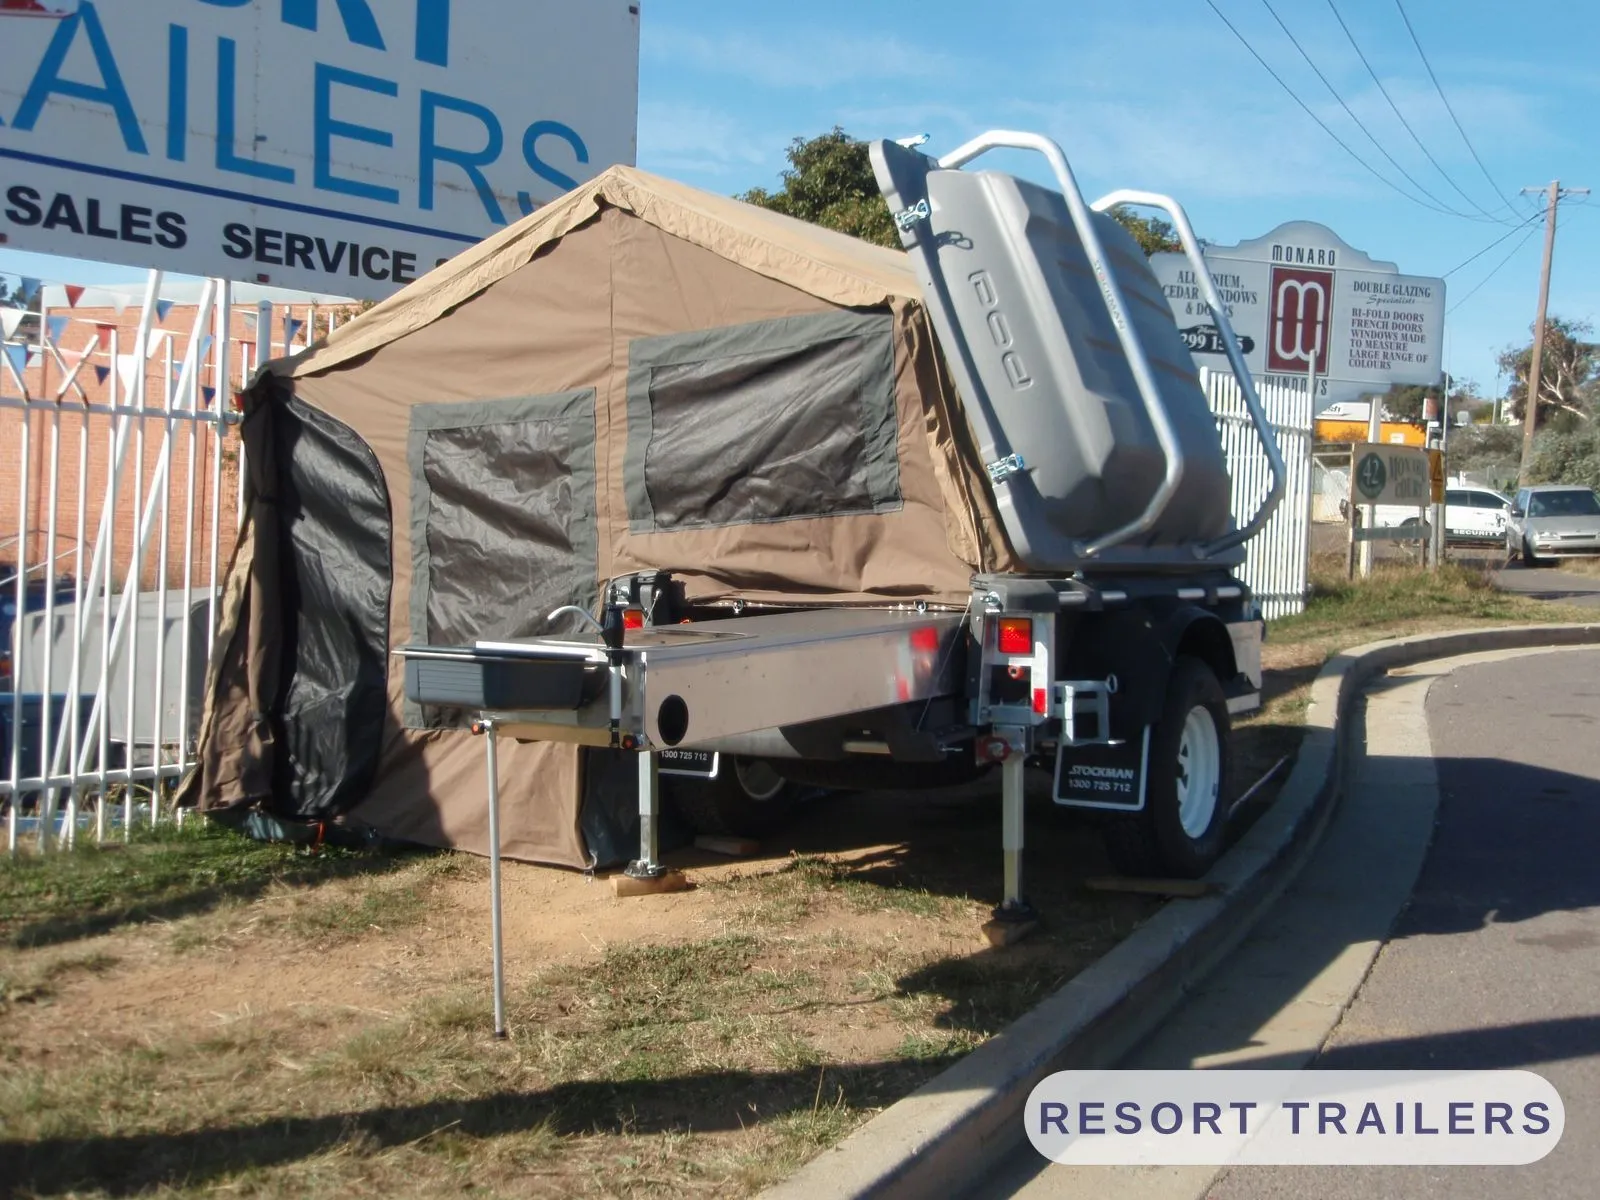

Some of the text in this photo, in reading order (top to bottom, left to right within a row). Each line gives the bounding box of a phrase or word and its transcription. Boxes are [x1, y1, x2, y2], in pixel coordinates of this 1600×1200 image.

[0, 0, 590, 226] AILERS
[5, 186, 417, 284] SALES SERVICE
[1272, 244, 1335, 266] MONARO
[1177, 270, 1245, 290] ALUNIUM,
[1162, 284, 1199, 300] CEDAR
[1353, 280, 1431, 299] DOUBLE GLAZING
[1185, 302, 1193, 315] &
[1352, 307, 1424, 323] BI-FOLD DOORS
[1351, 318, 1423, 334] FRENCH DOORS
[1351, 329, 1426, 344] WINDOWS MADE
[1350, 339, 1408, 351] TO MEASURE
[1349, 349, 1429, 364] LARGE RANGE OF
[1348, 359, 1391, 370] COLOURS
[1453, 529, 1501, 537] SECURITY
[661, 750, 708, 761] 1300 725 712
[1069, 764, 1133, 779] STOCKMAN
[1113, 783, 1132, 792] 712
